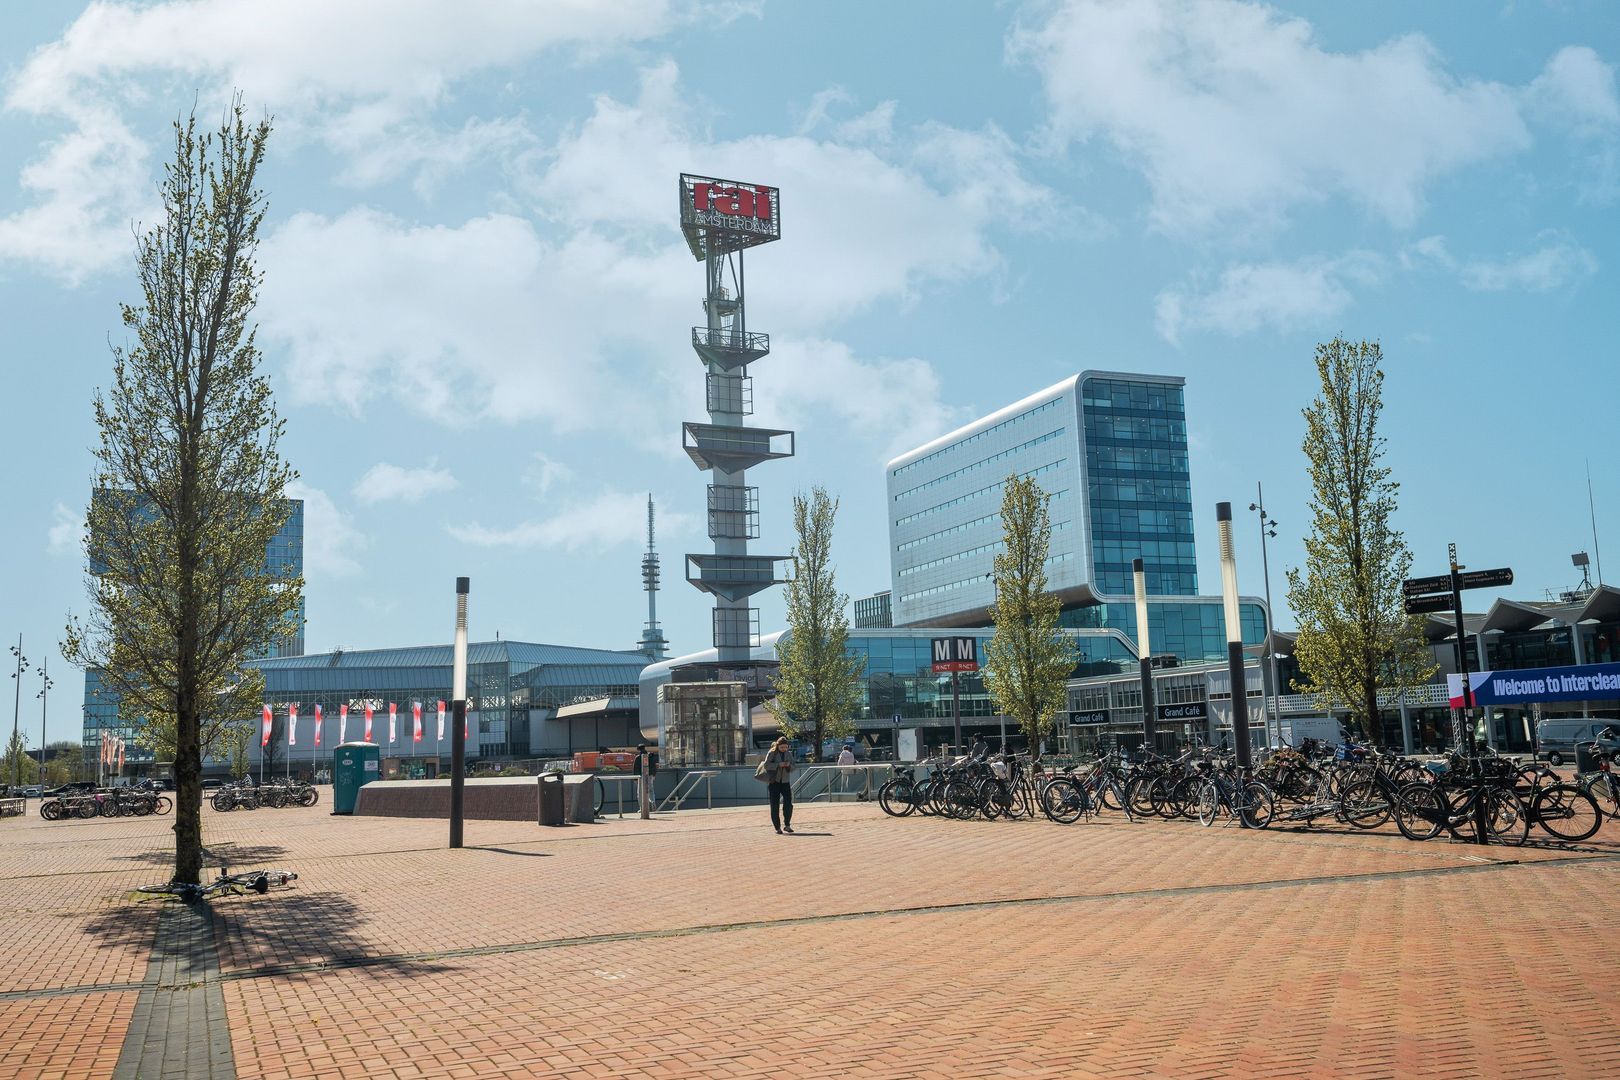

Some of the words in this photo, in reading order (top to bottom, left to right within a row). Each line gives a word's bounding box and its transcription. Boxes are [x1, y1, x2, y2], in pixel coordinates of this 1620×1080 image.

[694, 182, 769, 220] rai
[694, 213, 772, 234] AMSTERDAM
[935, 640, 950, 661] M
[957, 639, 973, 660] M
[1493, 679, 1545, 696] Welcome
[1546, 676, 1560, 693] to
[1074, 713, 1090, 723] Grand
[1091, 712, 1104, 721] Café
[1164, 706, 1183, 717] Grand
[1185, 705, 1200, 716] Café
